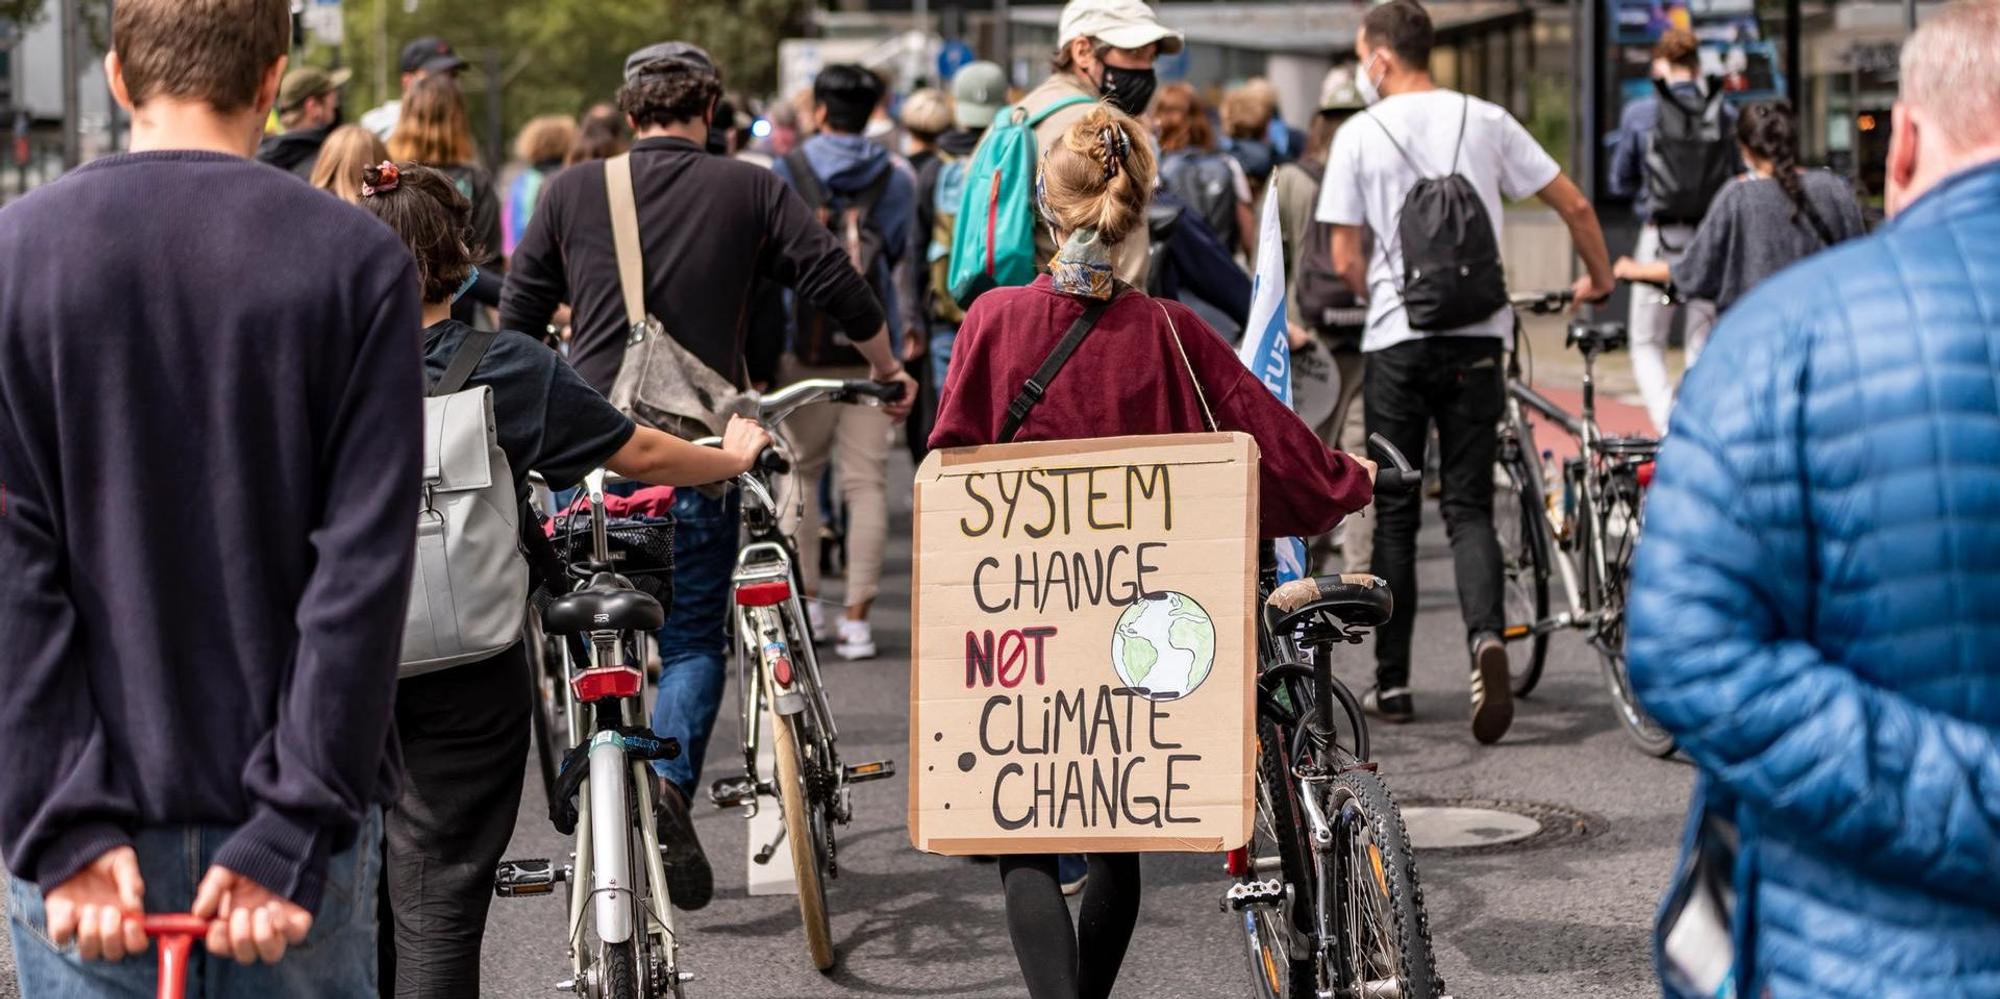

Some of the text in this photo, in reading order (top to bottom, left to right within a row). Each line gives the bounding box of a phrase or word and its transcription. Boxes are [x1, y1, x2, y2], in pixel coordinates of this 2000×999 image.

[960, 464, 1173, 539] SYSTEM
[973, 542, 1168, 614] CHANGE
[993, 755, 1202, 830] CHANGE
